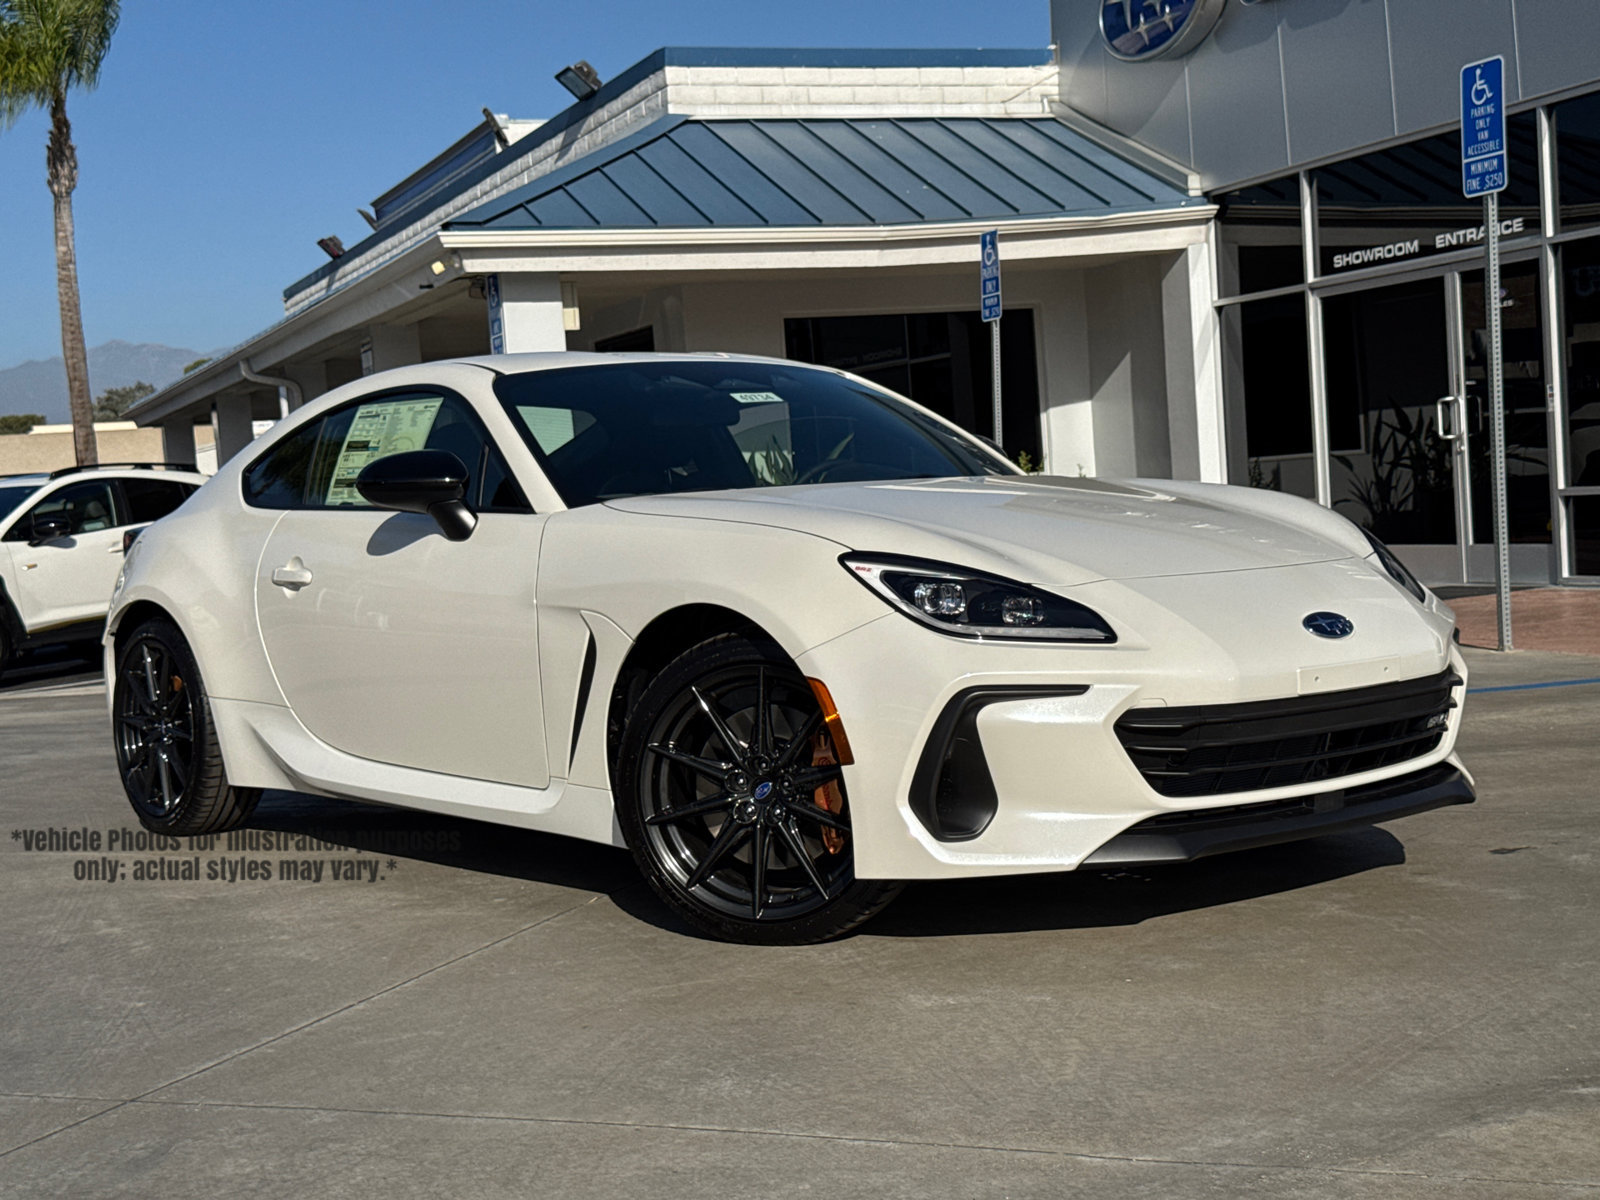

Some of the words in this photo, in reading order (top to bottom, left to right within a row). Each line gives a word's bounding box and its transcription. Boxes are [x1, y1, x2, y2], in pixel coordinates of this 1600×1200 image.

[1471, 104, 1495, 119] PARKING
[1475, 117, 1491, 130] ONLY
[1477, 130, 1489, 141] VAN
[1467, 139, 1500, 156] ACCESSIBLE
[1470, 158, 1498, 175] MINIMUM
[1466, 178, 1481, 192] FINE
[1483, 172, 1503, 190] $250
[1333, 239, 1419, 268] SHOWROOM
[1435, 217, 1525, 249] ENTRACE
